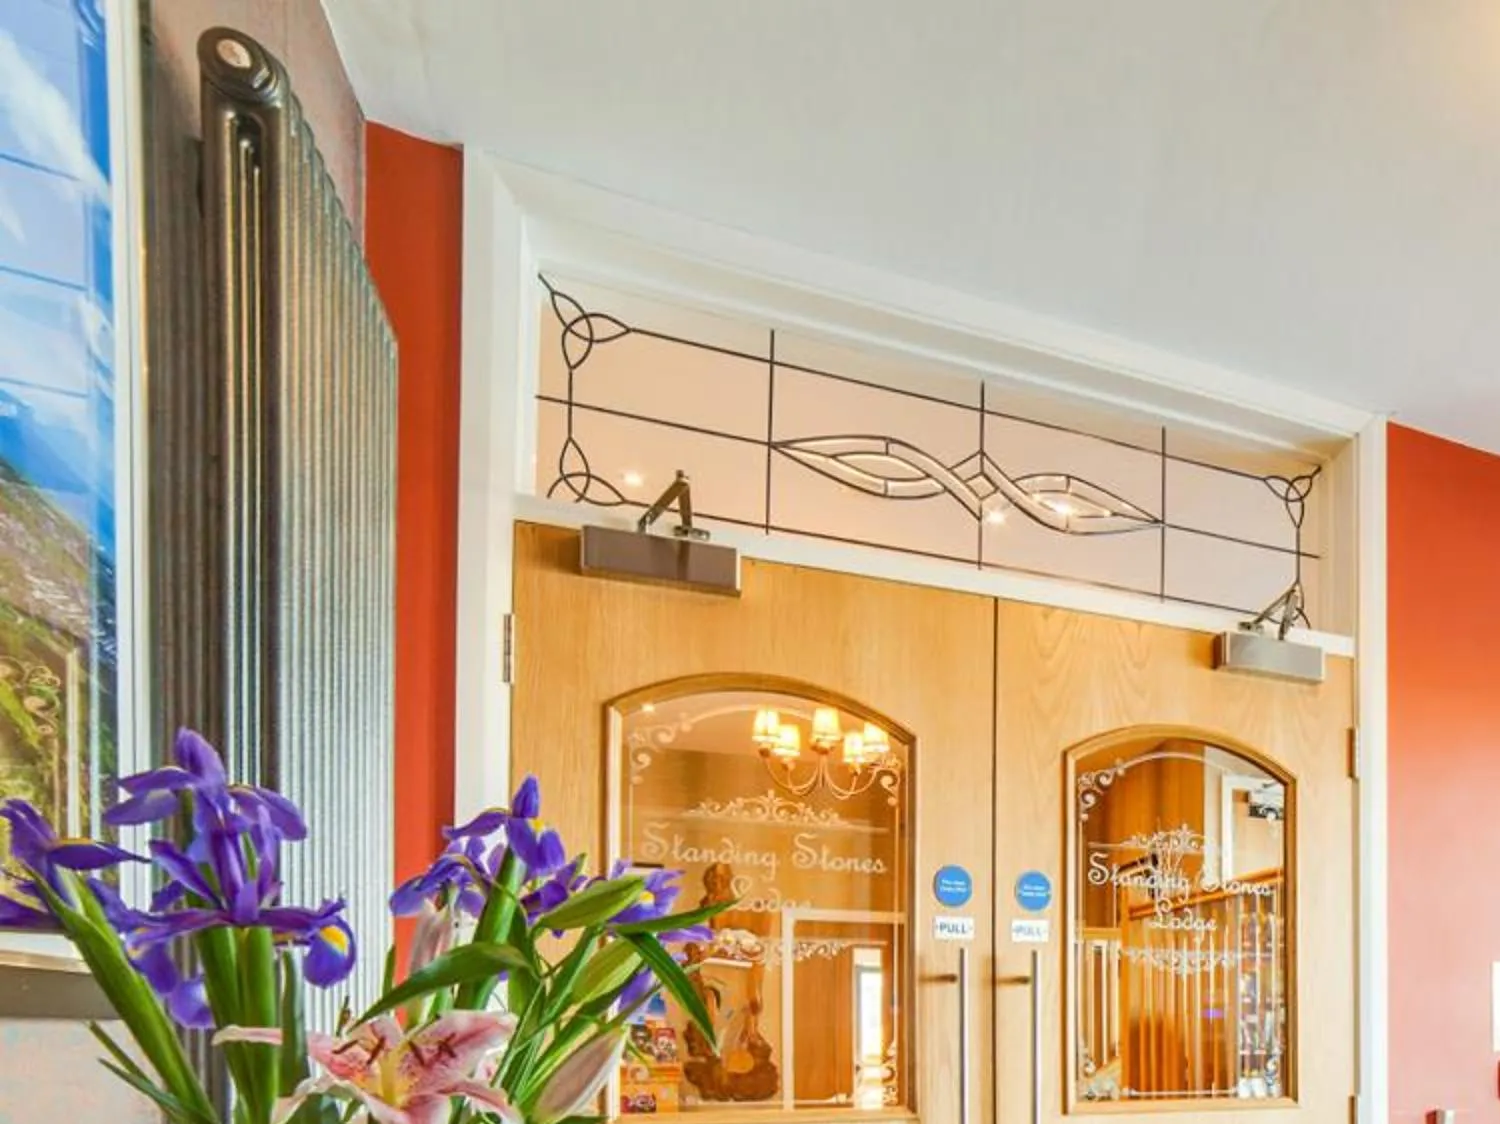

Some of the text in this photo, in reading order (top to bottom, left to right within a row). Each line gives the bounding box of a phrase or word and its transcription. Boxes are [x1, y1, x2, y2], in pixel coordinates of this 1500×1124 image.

[641, 821, 887, 881] Standing Stones
[939, 922, 967, 935] PULL
[1149, 899, 1218, 943] Lodge
